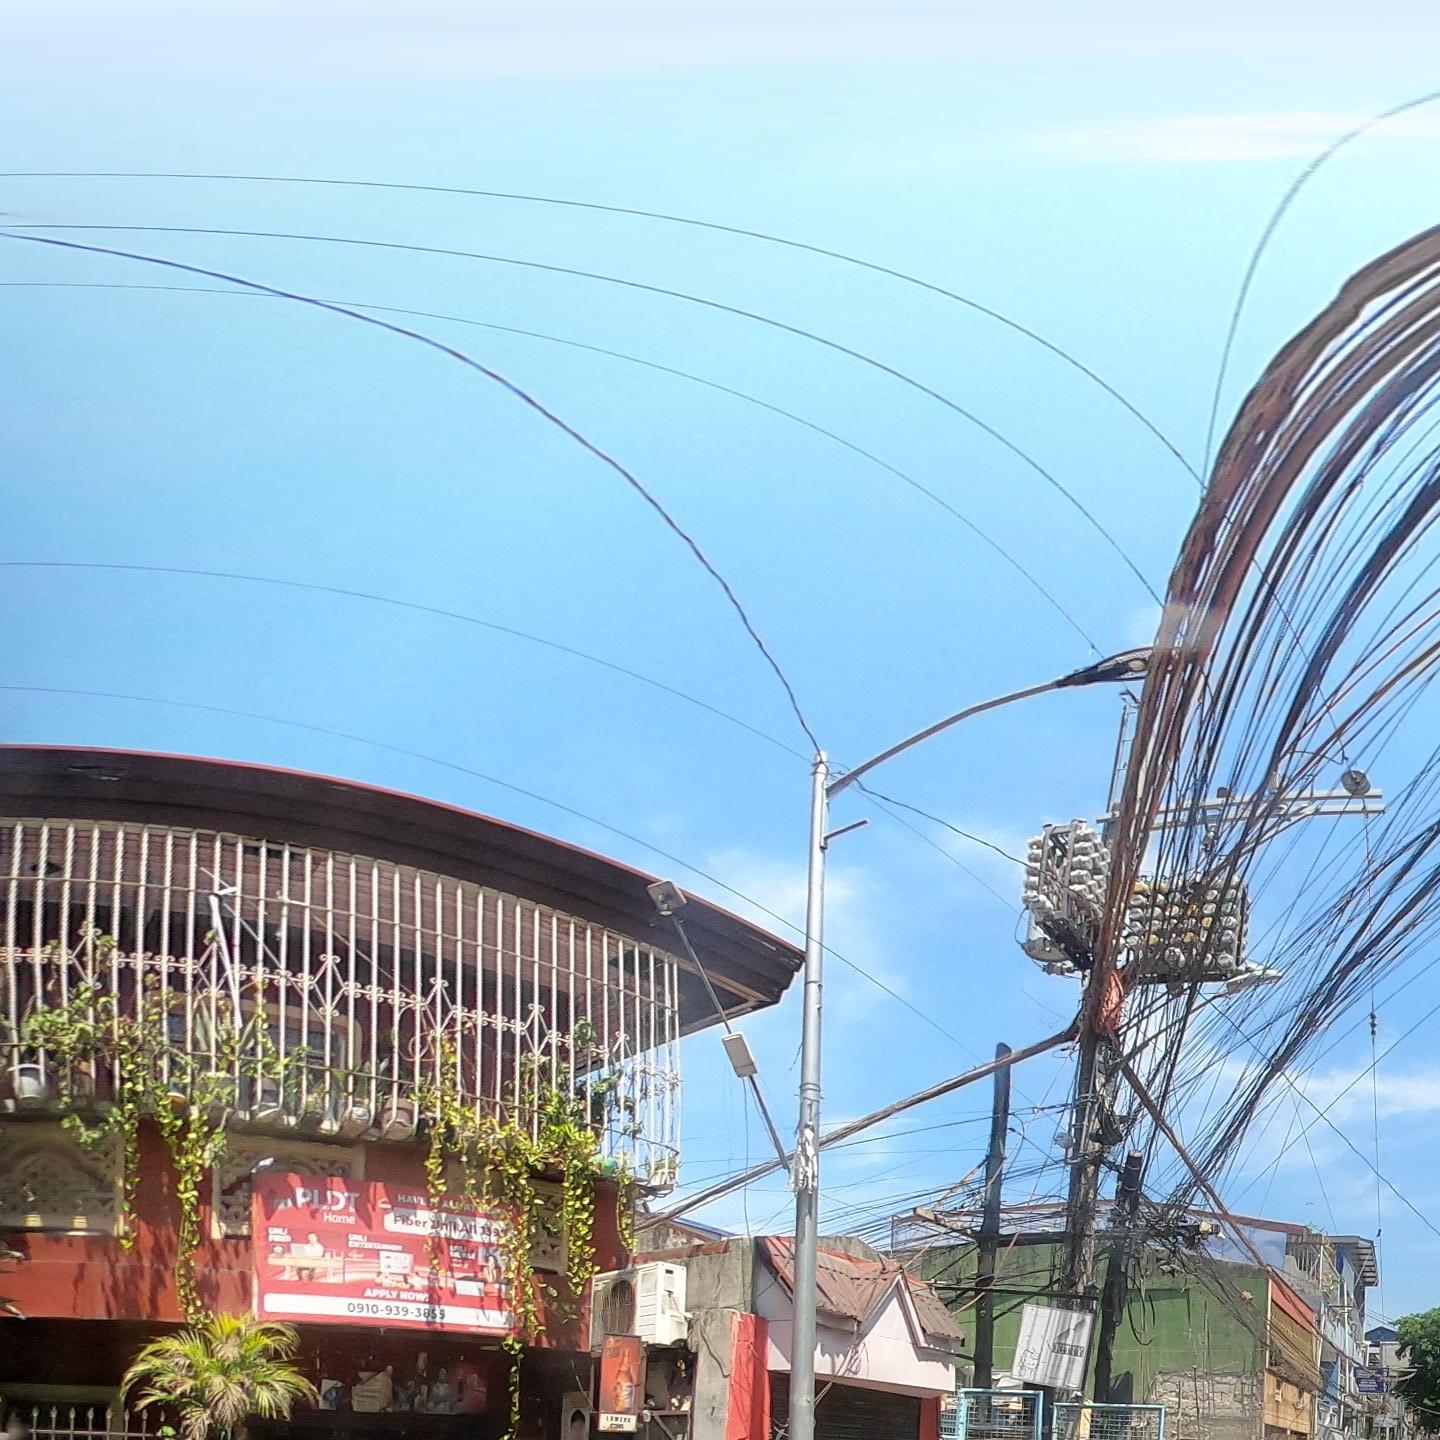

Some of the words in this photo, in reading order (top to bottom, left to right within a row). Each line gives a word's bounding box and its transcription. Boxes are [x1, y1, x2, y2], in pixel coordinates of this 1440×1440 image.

[295, 1186, 360, 1213] PLDT
[323, 1212, 356, 1225] Home
[393, 1213, 427, 1229] Fiber
[364, 1287, 398, 1299] APPLY
